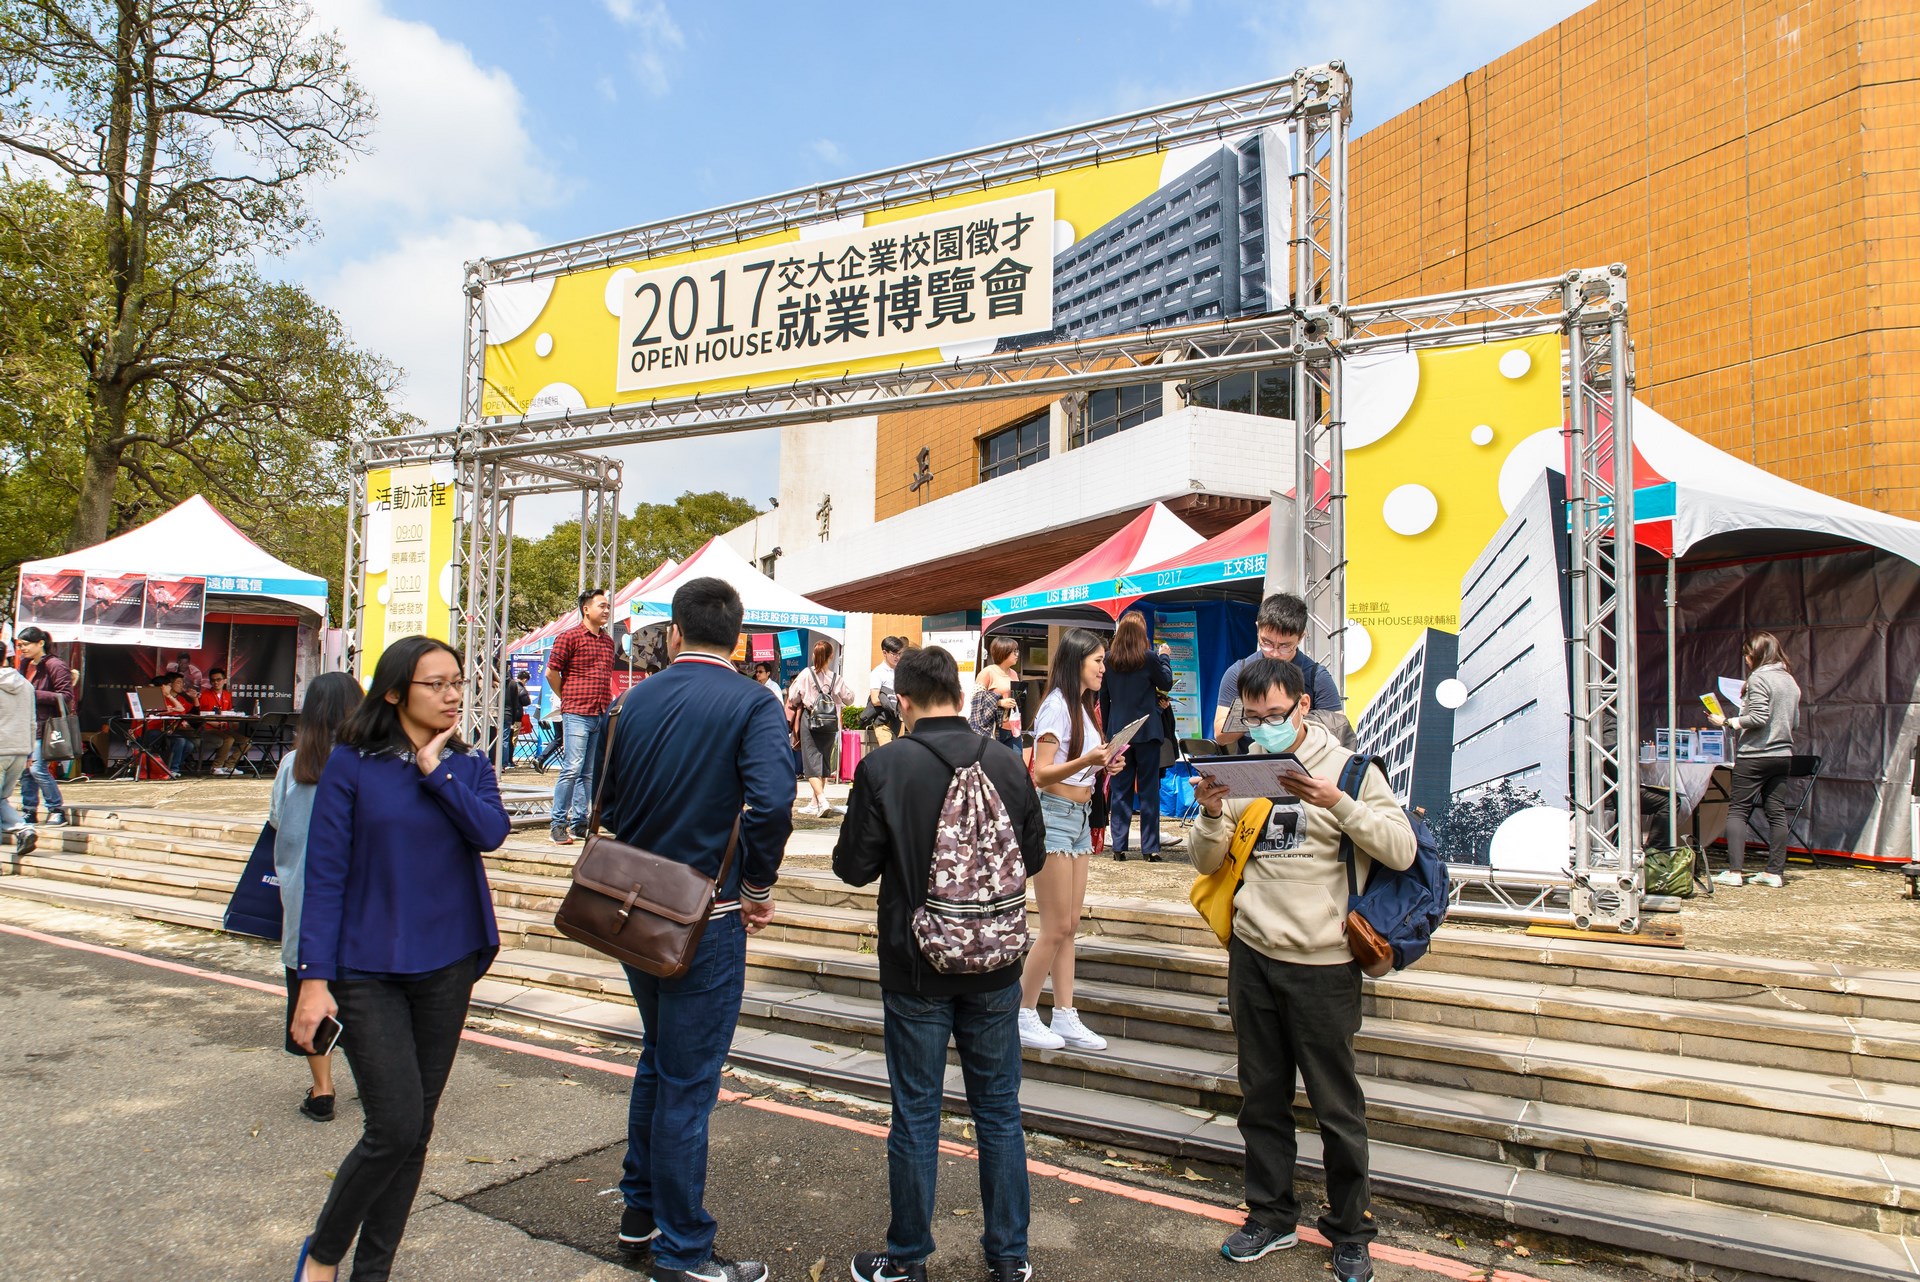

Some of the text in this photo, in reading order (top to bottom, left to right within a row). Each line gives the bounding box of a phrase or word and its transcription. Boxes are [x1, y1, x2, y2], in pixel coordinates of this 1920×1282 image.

[632, 212, 1034, 347] 2017 交大企業校園徵才
[631, 257, 1033, 373] OPEN HOUSE 就業博覽會
[376, 482, 446, 511] 活動流程
[396, 524, 423, 539] 09:00
[1223, 557, 1266, 576] 正文科技
[207, 577, 264, 591] 遠傳電信
[395, 575, 421, 590] 10:10
[1157, 570, 1182, 586] D217
[1010, 596, 1028, 609] D216
[1046, 590, 1060, 603] USI
[1348, 602, 1390, 612] 主辦單位
[1347, 617, 1376, 626] OPEN
